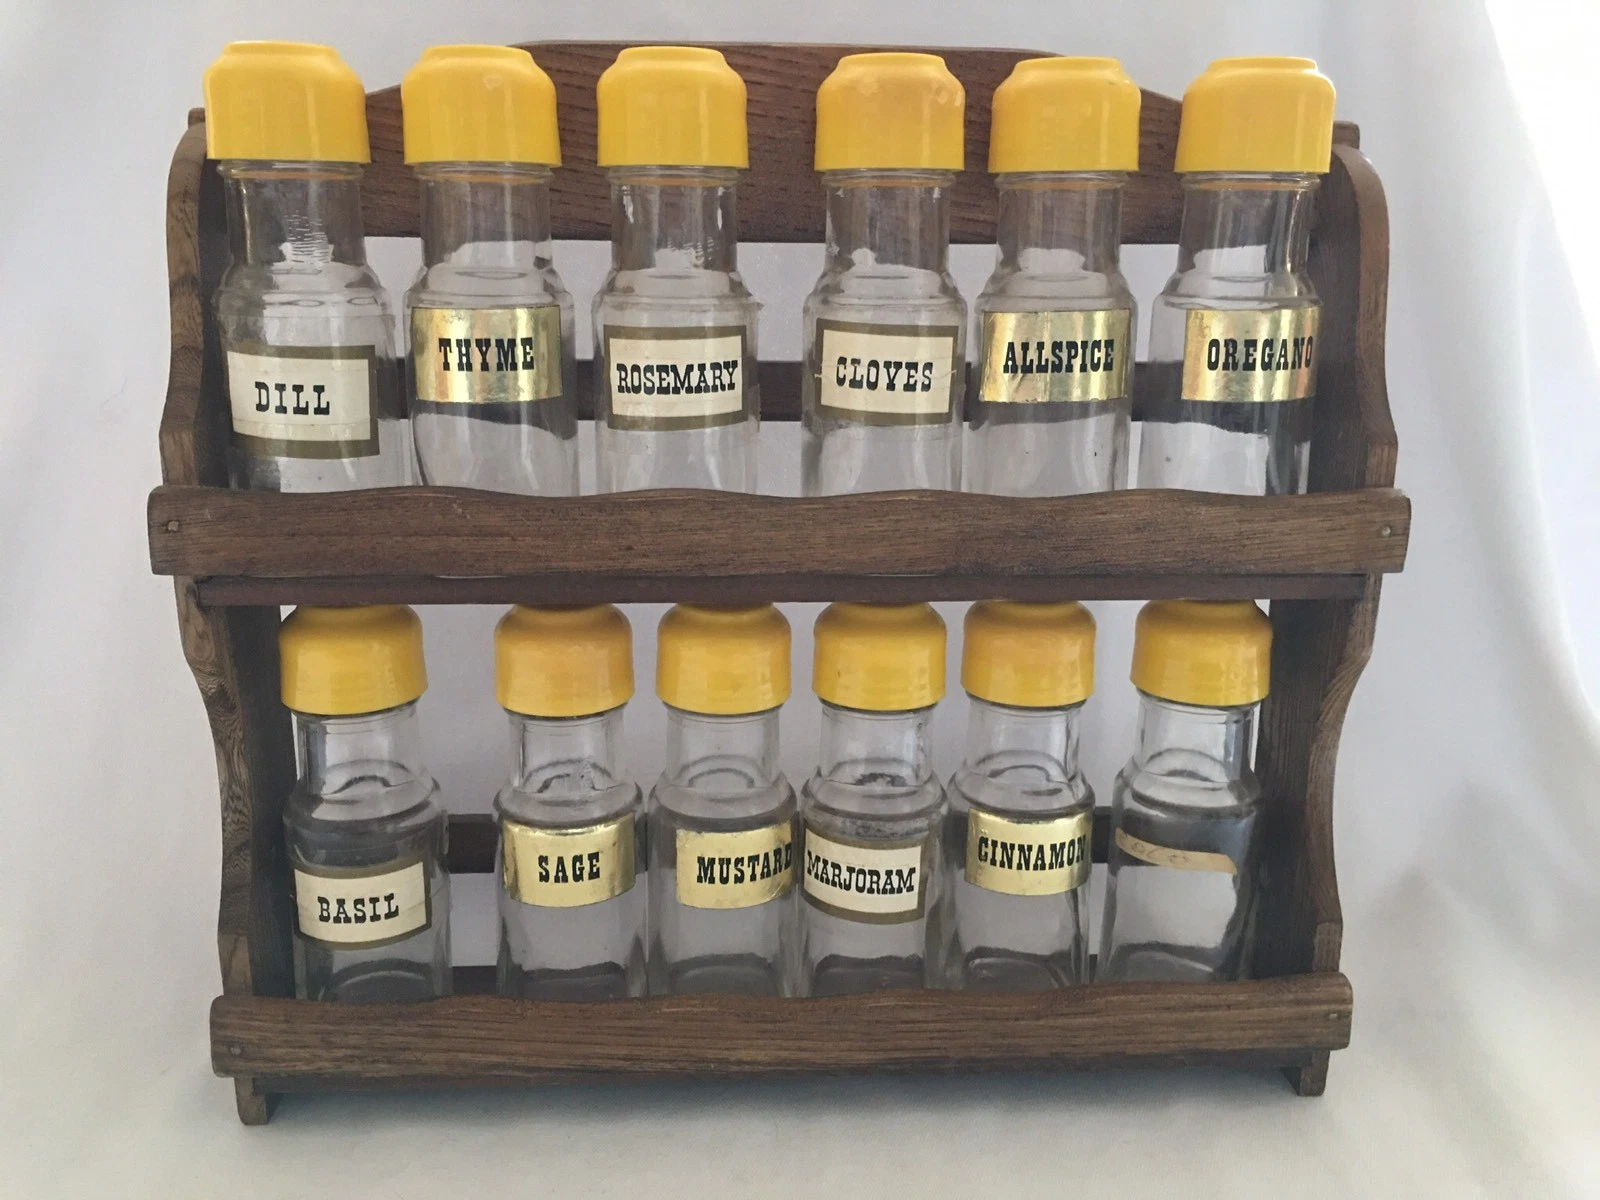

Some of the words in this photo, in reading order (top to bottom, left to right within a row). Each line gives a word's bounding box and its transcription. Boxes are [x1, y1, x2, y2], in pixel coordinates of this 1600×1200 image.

[438, 337, 535, 372] THYME
[1003, 339, 1115, 374] ALLSPICE
[1207, 335, 1314, 372] OREGANO
[616, 360, 739, 395] ROSEMARY
[836, 356, 934, 392] CLOVES
[255, 381, 330, 416] DILL
[538, 851, 601, 884] SAGE
[977, 834, 1087, 871] CINNAMON
[807, 849, 916, 895] MARJORAM
[317, 892, 400, 924] BASIL
